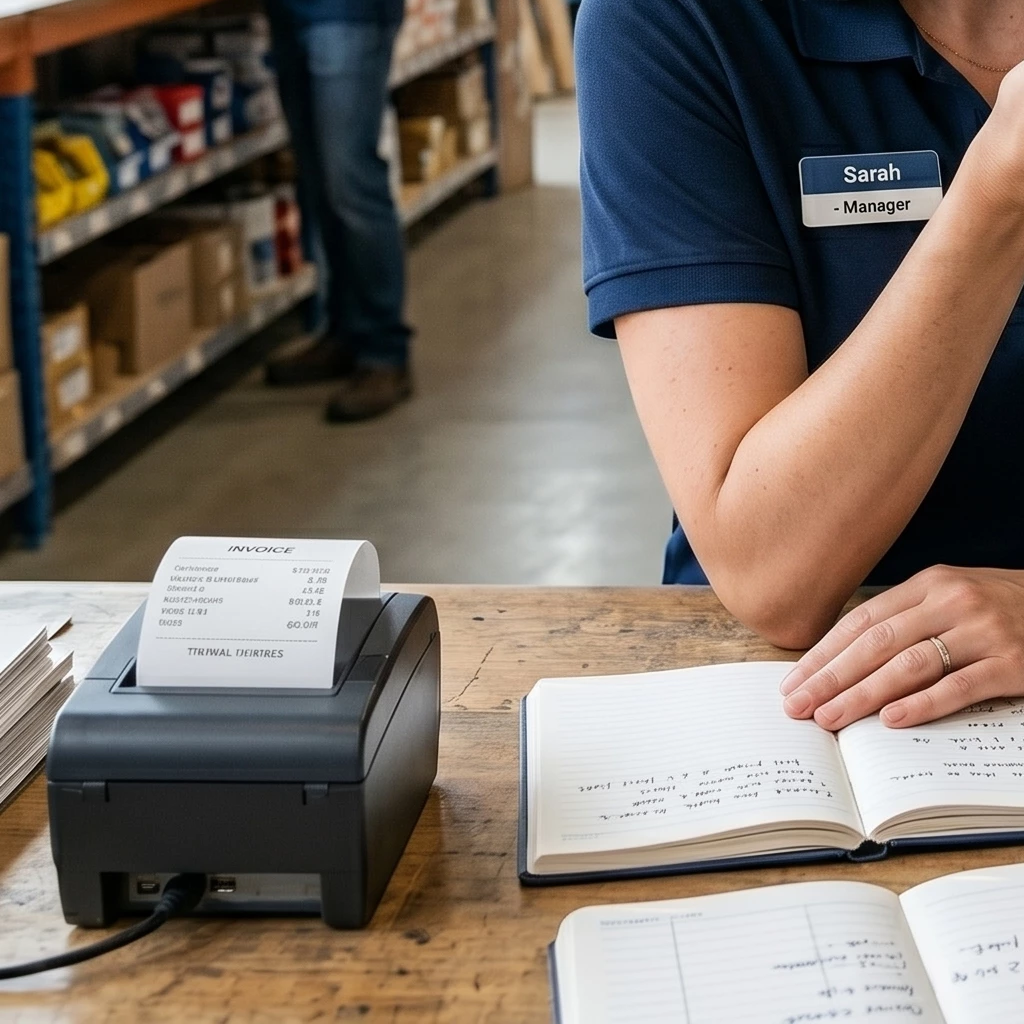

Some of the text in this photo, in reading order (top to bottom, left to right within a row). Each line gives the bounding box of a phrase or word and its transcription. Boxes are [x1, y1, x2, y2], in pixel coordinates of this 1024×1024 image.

[843, 163, 901, 183] Sarah
[843, 199, 911, 215] Manager
[227, 545, 296, 554] INVOICE
